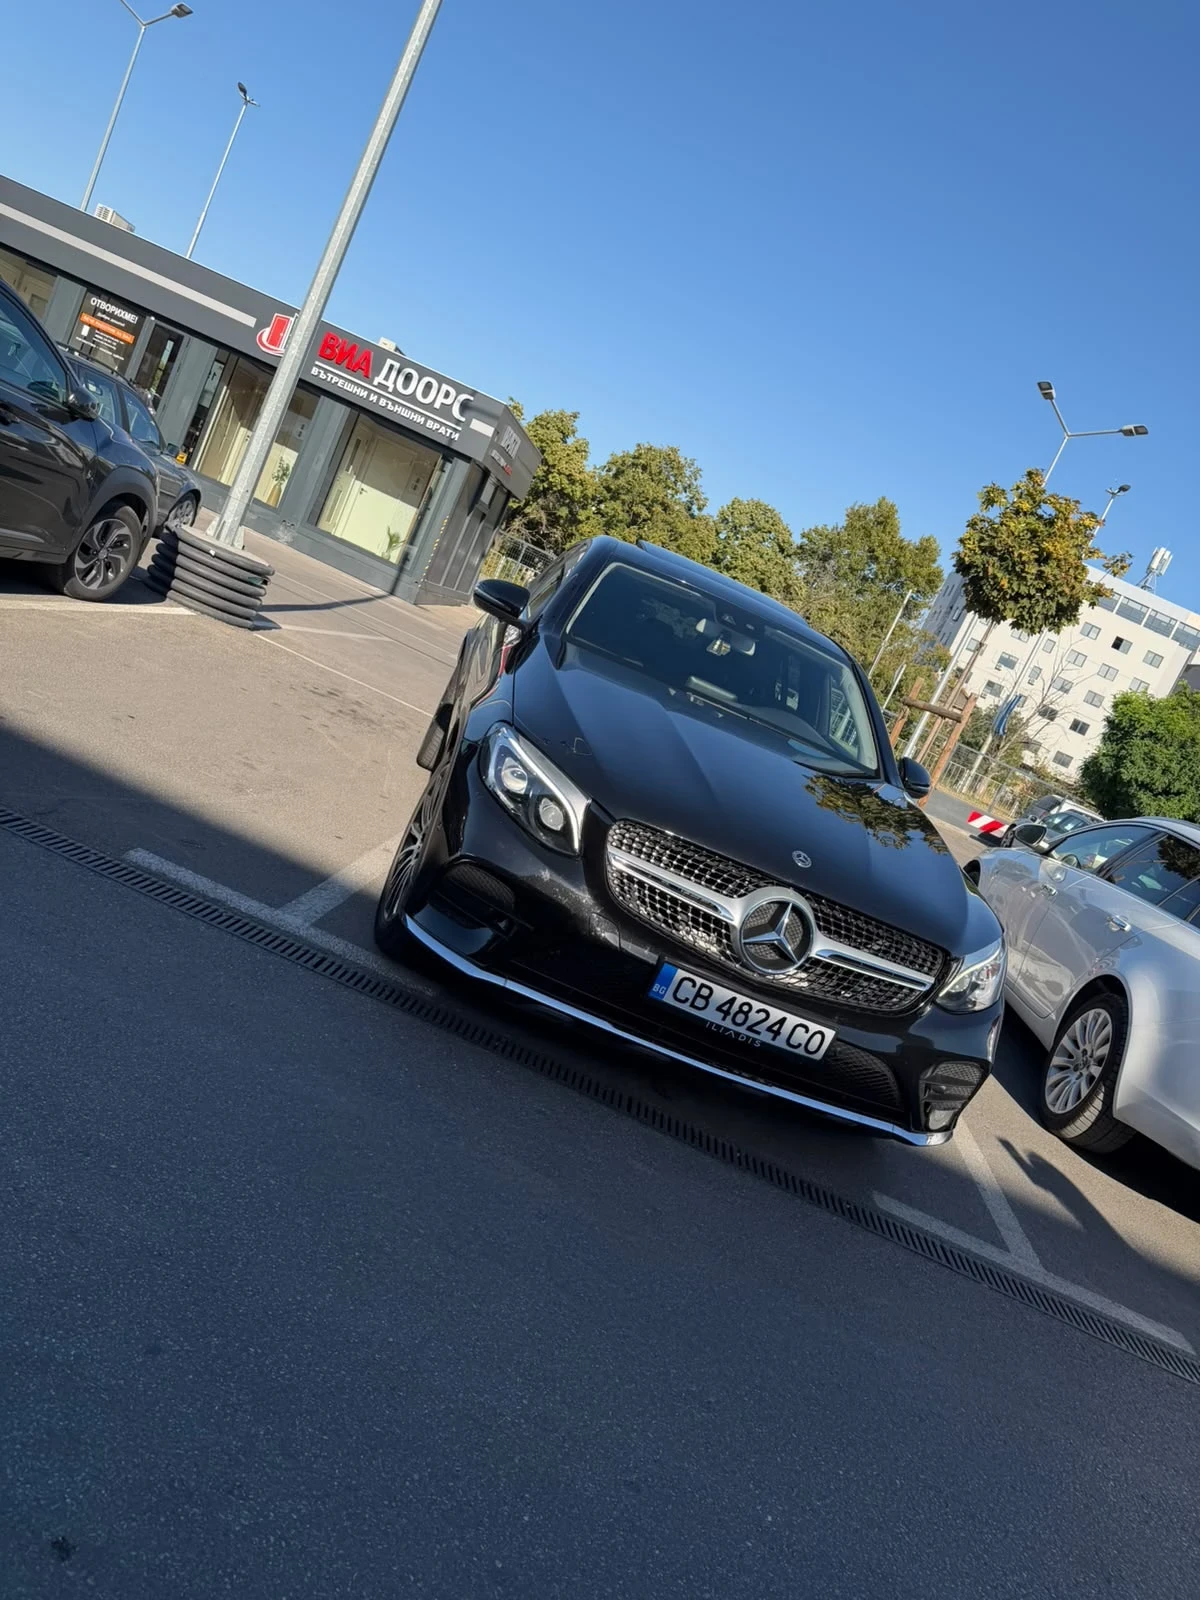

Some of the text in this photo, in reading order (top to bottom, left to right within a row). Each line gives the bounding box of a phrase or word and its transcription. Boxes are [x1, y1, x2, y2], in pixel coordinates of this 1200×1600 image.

[90, 297, 138, 324] ОТВОРИХМЕ!
[311, 366, 460, 441] ВЪТРЕШНИ И ВЪНШНИ ВРАТИ
[318, 332, 474, 422] ВИА ДООРС
[652, 983, 667, 995] BG
[672, 976, 714, 1011] CB
[715, 996, 787, 1042] 4824
